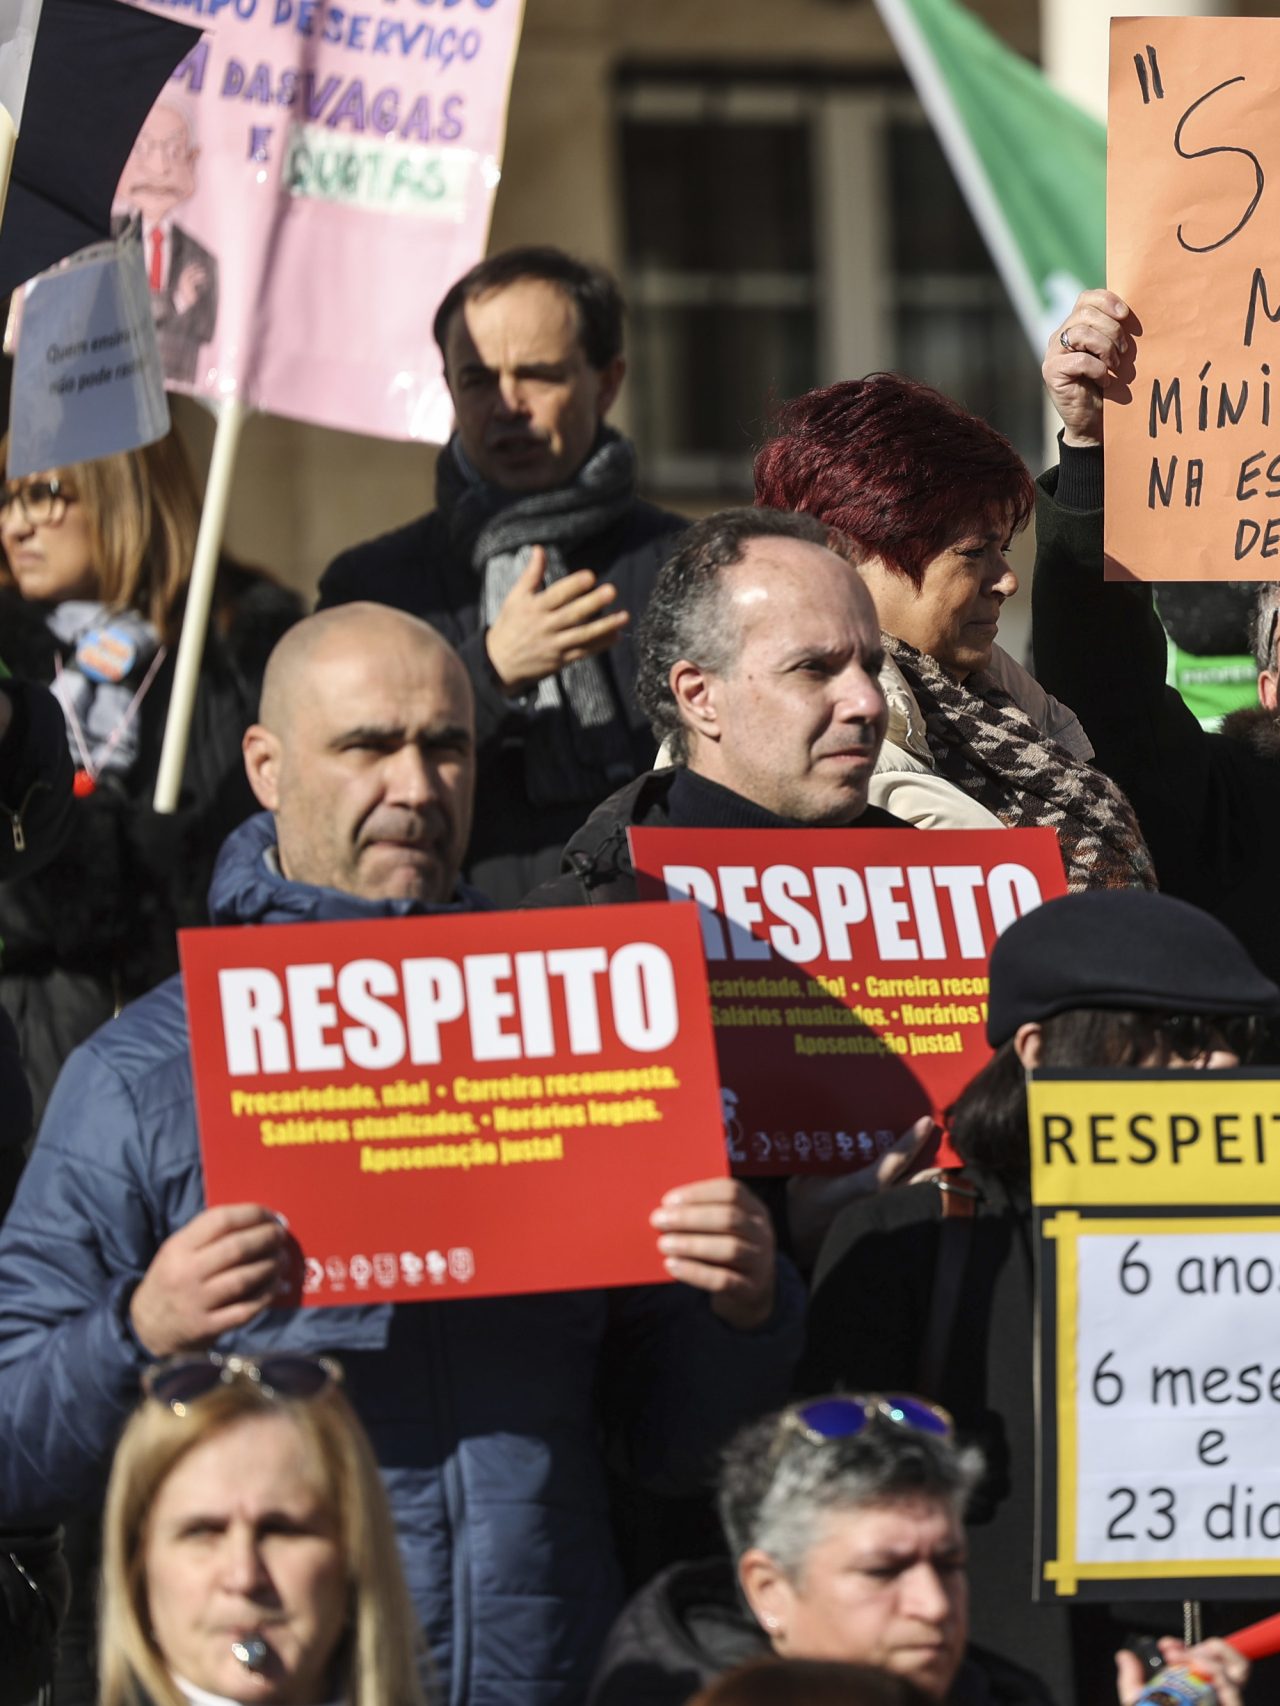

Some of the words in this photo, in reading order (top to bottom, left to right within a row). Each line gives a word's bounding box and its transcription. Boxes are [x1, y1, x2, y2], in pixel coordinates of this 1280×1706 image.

[1149, 456, 1203, 509] NA
[662, 863, 1043, 963] RESPEITO
[217, 942, 679, 1076] RESPEITO
[709, 976, 808, 999] cariedade,
[865, 976, 941, 998] Carreira
[902, 1003, 980, 1026] Horários
[909, 1031, 963, 1056] justa!
[453, 1074, 543, 1103] Carreira
[260, 1117, 350, 1147] Salários
[1120, 1241, 1150, 1295] 6
[1093, 1352, 1123, 1406] 6
[1198, 1430, 1228, 1466] e
[1108, 1487, 1175, 1541] 23
